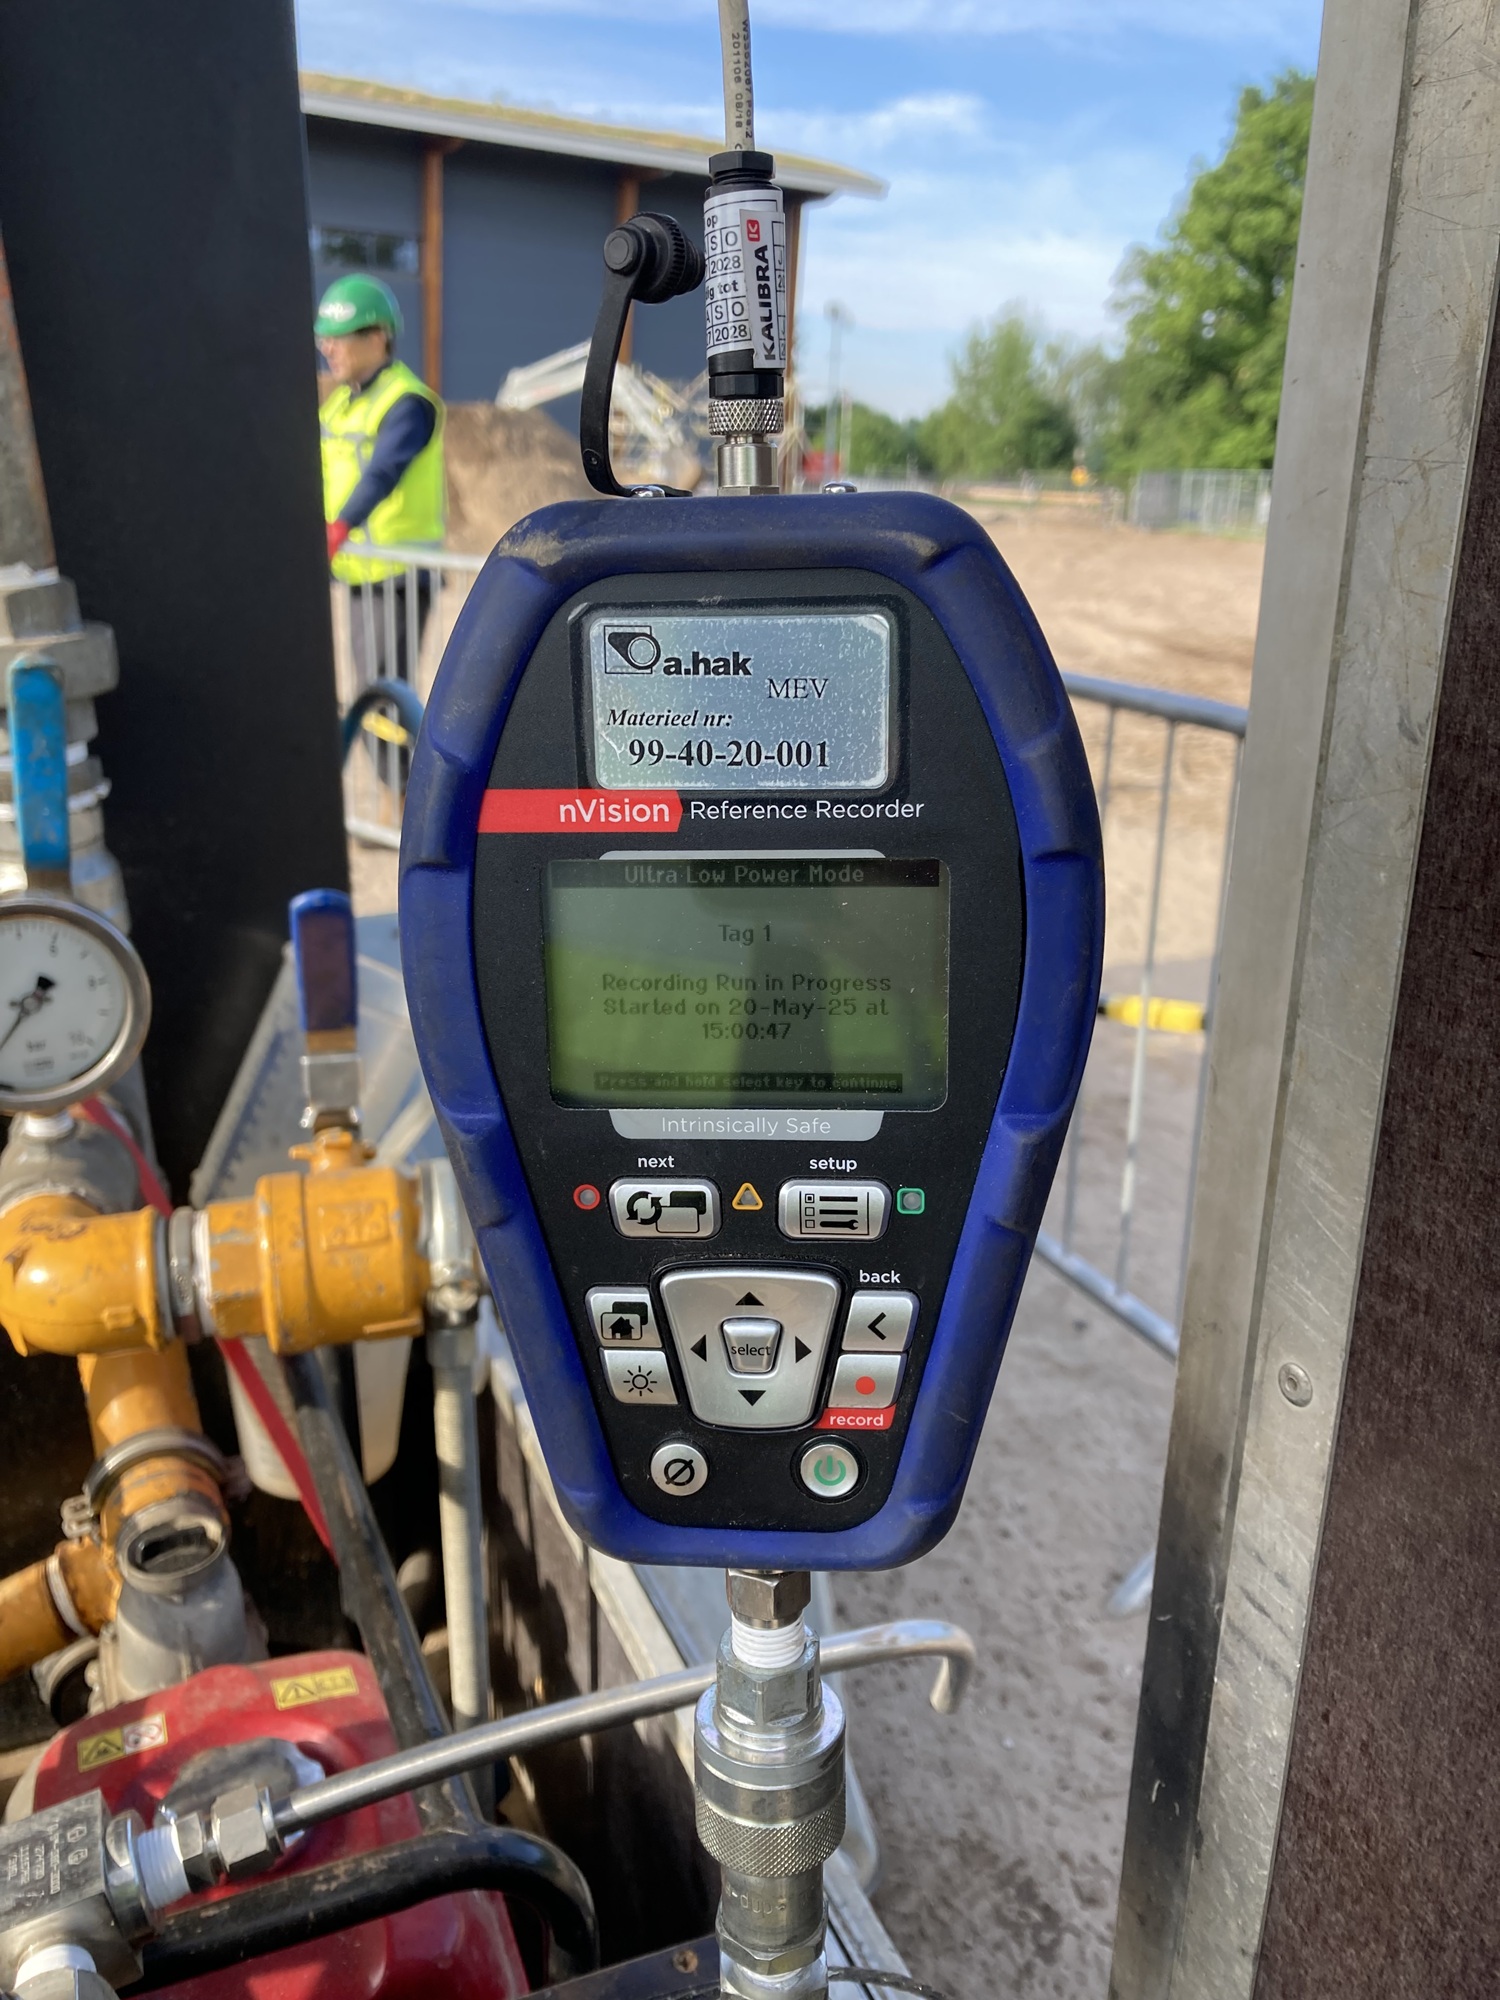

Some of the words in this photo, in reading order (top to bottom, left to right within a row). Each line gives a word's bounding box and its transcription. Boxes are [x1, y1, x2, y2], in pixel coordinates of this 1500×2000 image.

[707, 214, 718, 228] op
[710, 235, 718, 251] S
[710, 255, 741, 274] 2028
[718, 280, 739, 295] tot
[755, 244, 776, 360] KALIBRA
[715, 325, 748, 342] 2028
[663, 652, 752, 677] a.hak
[767, 678, 828, 699] MEV
[606, 709, 698, 727] Materieel
[703, 713, 733, 727] nr:
[628, 739, 829, 768] 99-40-20-001
[559, 798, 670, 823] nVision
[690, 800, 807, 820] Reference
[816, 799, 925, 820] Recorder
[624, 866, 678, 884] Ultra
[687, 866, 727, 884] Low
[735, 866, 799, 884] Power
[809, 866, 865, 884] Mode
[718, 924, 755, 946] Tag
[762, 925, 772, 942] 1
[602, 974, 708, 995] Recording
[716, 974, 756, 992] Run
[765, 974, 784, 992] in
[793, 974, 892, 995] Progress
[603, 999, 687, 1016] Started
[695, 1002, 720, 1016] on
[729, 999, 857, 1020] 20-May-25
[865, 999, 890, 1016] at
[702, 1022, 792, 1040] 15:00:47
[654, 1075, 679, 1088] and
[685, 1075, 716, 1089] hold
[722, 1076, 770, 1089] select
[776, 1077, 803, 1090] key
[810, 1077, 827, 1089] to
[832, 1078, 898, 1089] continue
[662, 1117, 778, 1137] Intrinsically
[787, 1117, 832, 1135] Safe
[637, 1155, 675, 1169] next
[809, 1157, 858, 1171] setup
[859, 1270, 901, 1284] back
[731, 1343, 771, 1357] select
[829, 1413, 884, 1427] record
